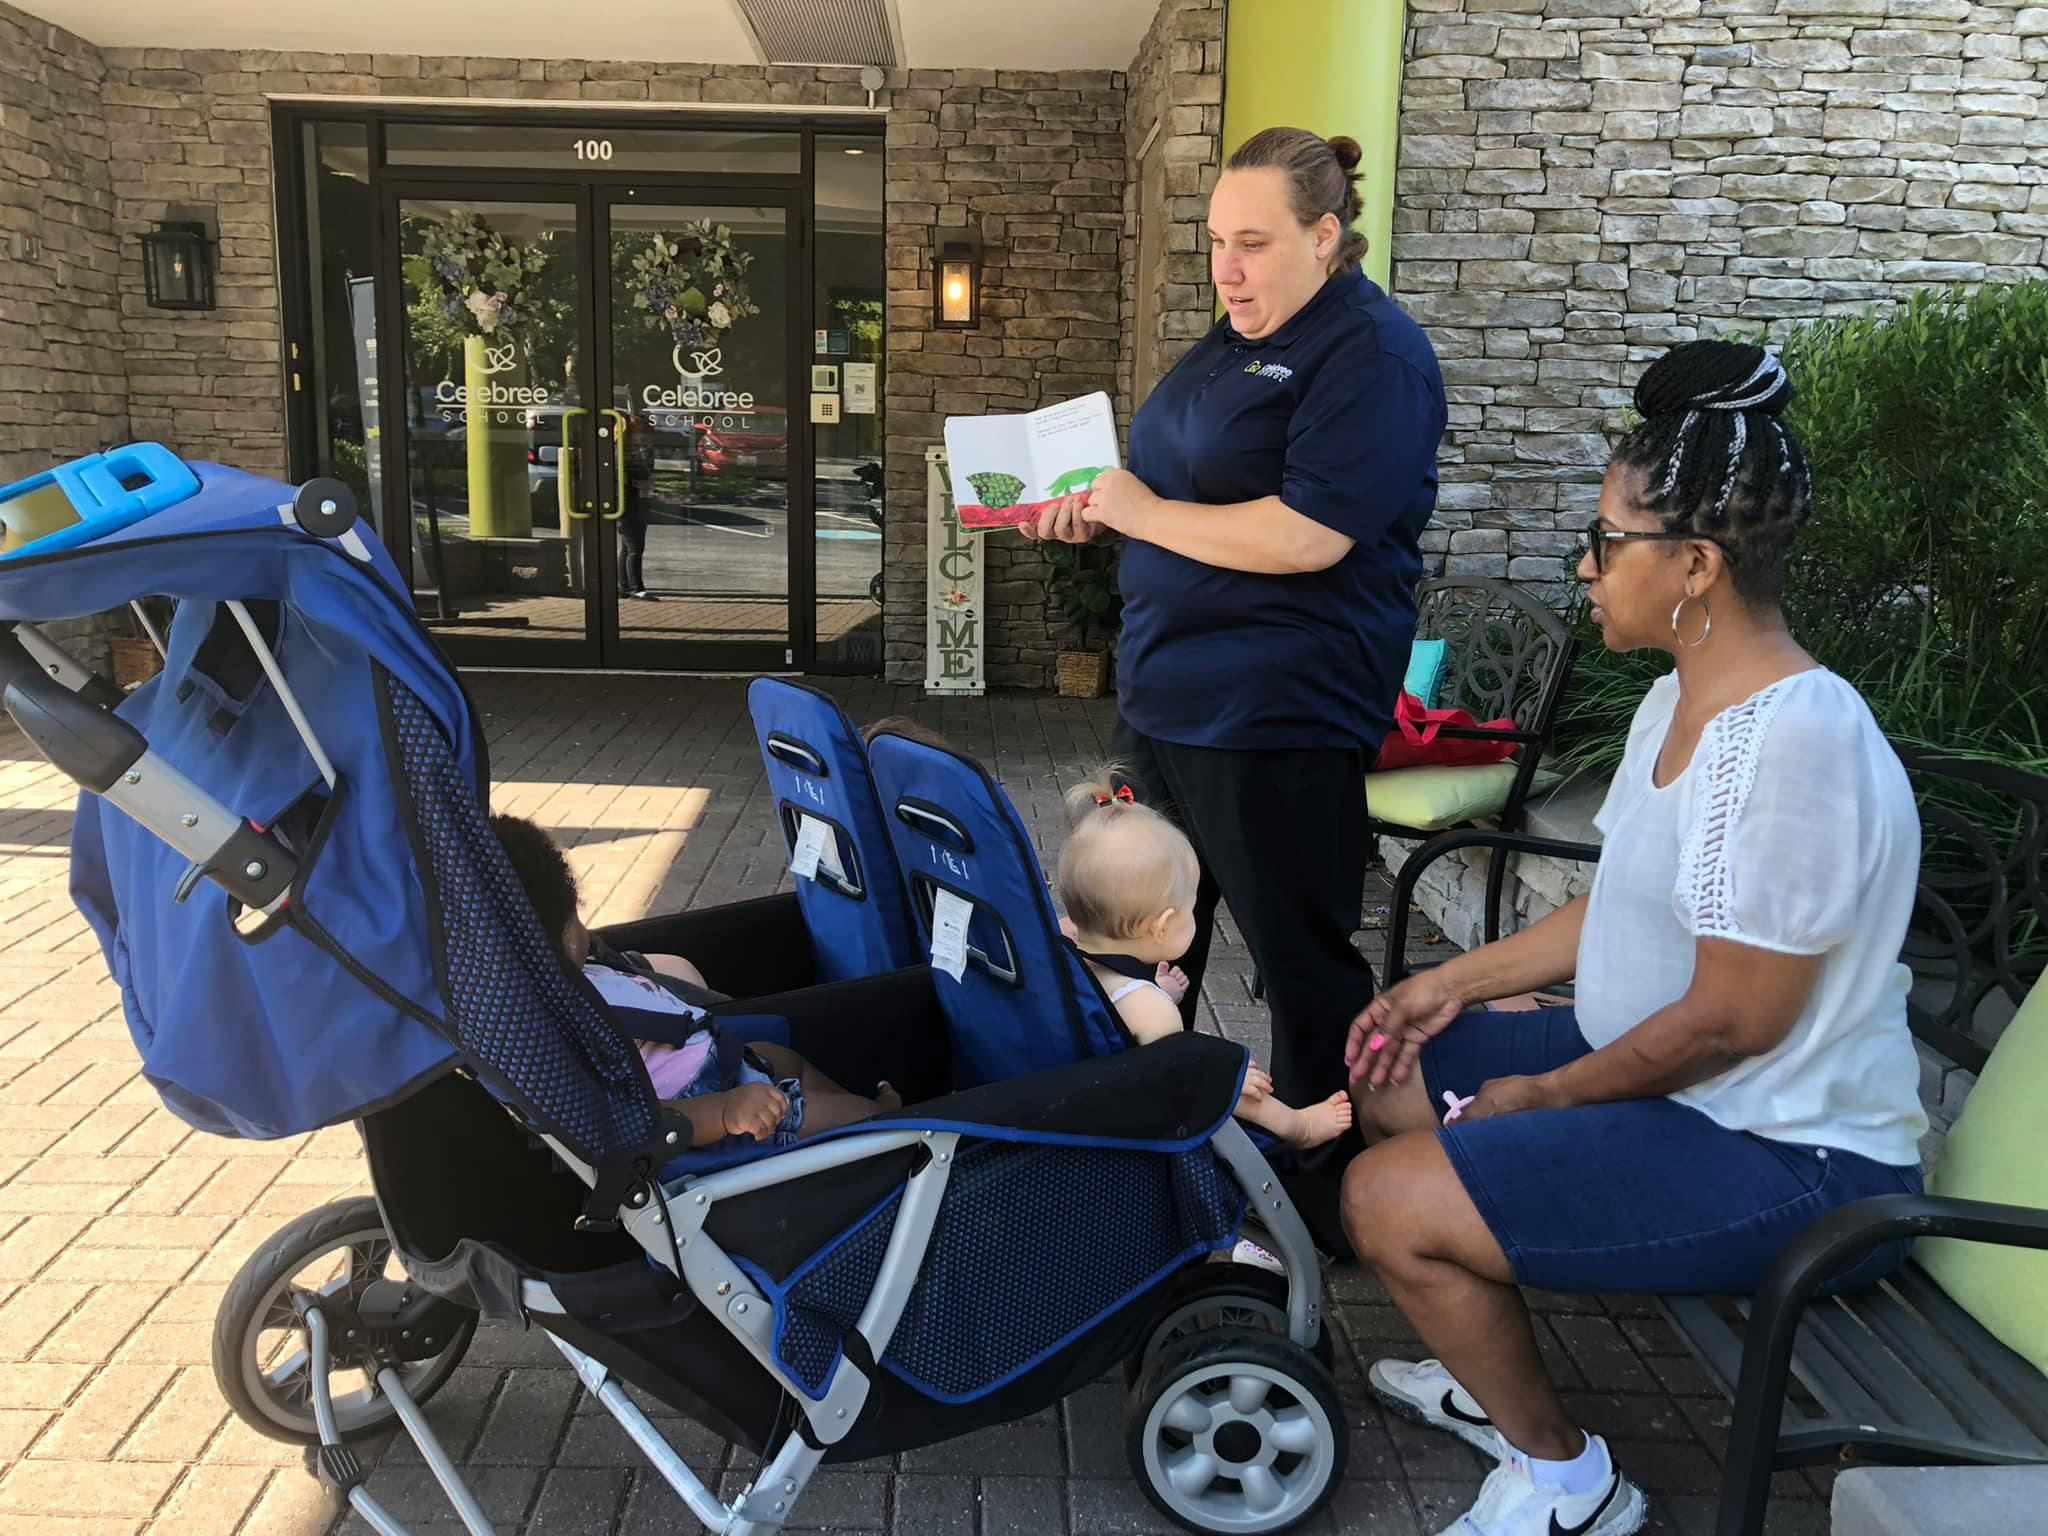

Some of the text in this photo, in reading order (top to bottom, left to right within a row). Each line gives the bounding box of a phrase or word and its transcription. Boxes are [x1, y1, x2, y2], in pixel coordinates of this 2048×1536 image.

[573, 139, 613, 160] 100
[436, 380, 549, 404] Ceebree
[642, 384, 754, 409] Celebree
[648, 414, 751, 429] SCHOOL
